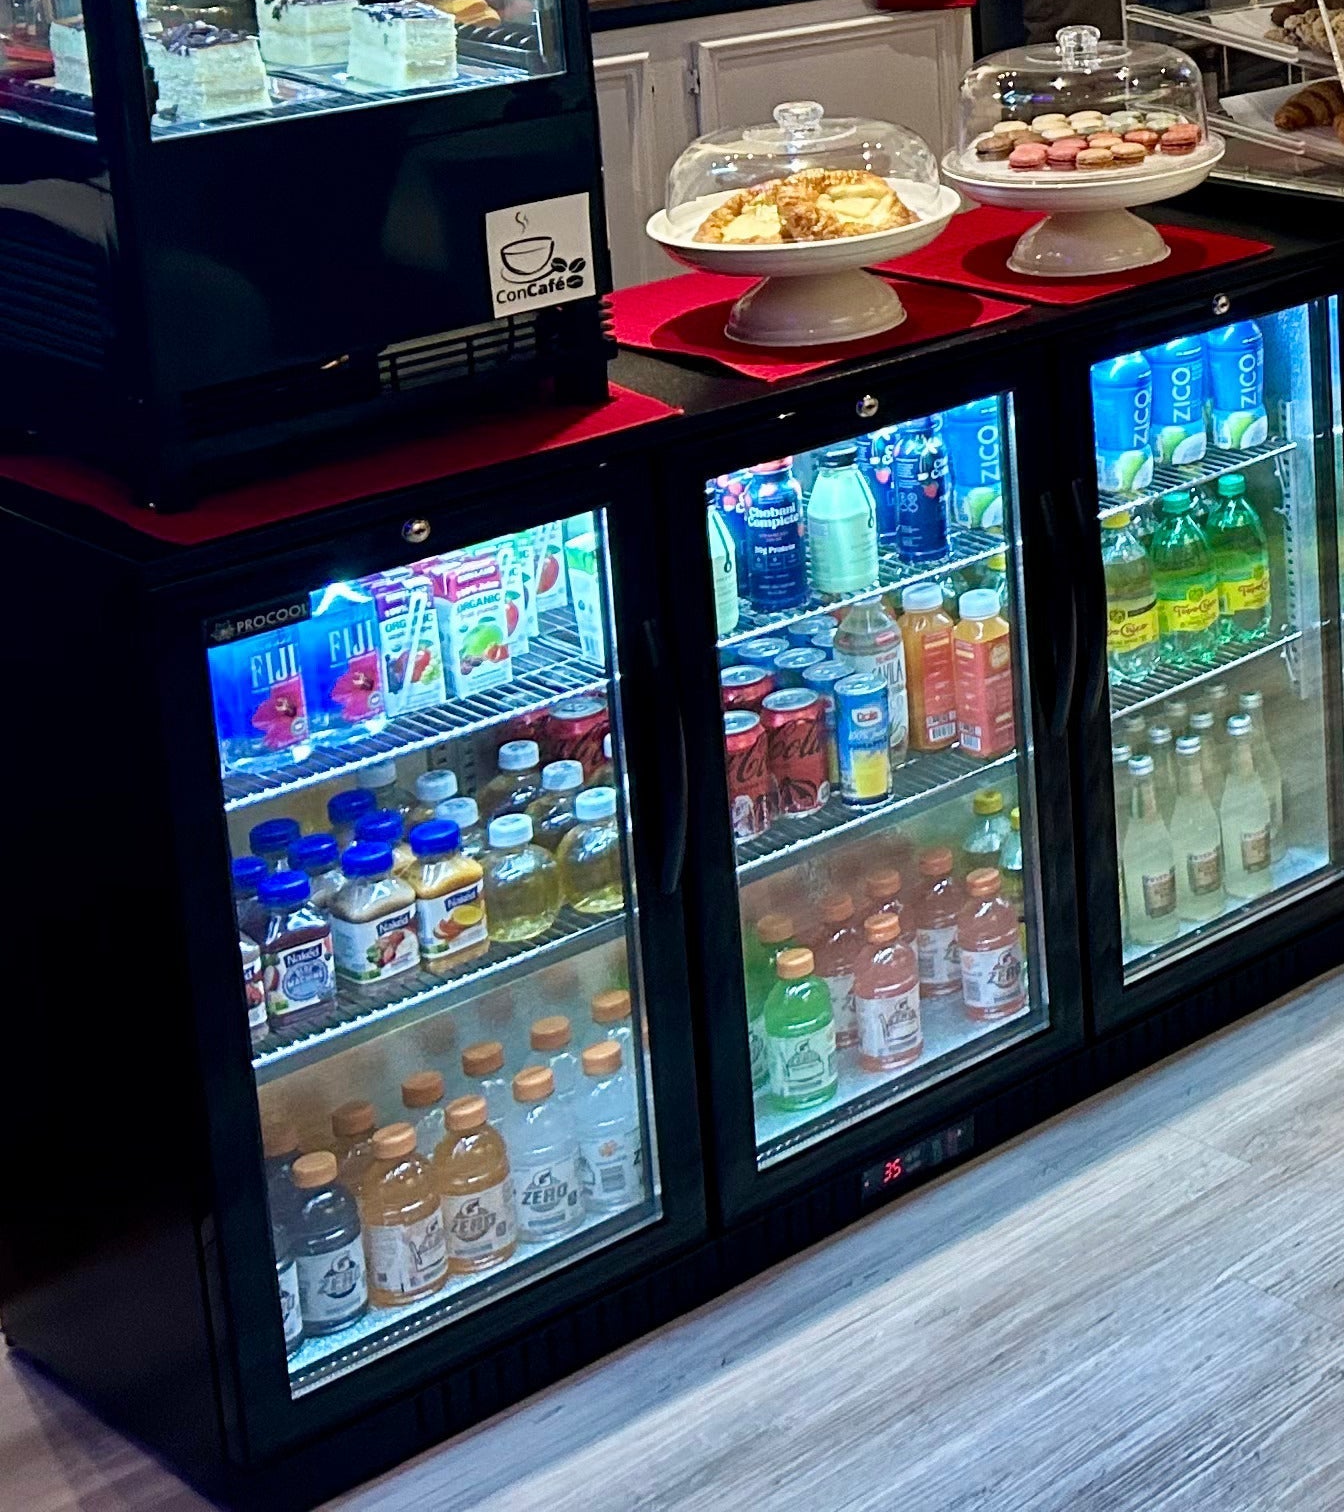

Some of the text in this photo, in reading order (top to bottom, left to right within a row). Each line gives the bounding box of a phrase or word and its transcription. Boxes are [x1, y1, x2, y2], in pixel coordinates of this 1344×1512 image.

[496, 276, 565, 304] ConCafé
[1239, 353, 1257, 409] ZICO
[1171, 367, 1191, 424] ZICO
[1134, 389, 1150, 448] ZICO
[977, 425, 1000, 484] ZICO
[748, 513, 799, 530] Complete
[749, 502, 796, 518] Chobani
[457, 593, 501, 613] ORGANIC
[329, 620, 375, 663] FIJI
[251, 644, 299, 688] FIJI
[857, 711, 878, 722] Dole
[448, 890, 477, 908] Naked
[377, 914, 410, 934] Naked
[286, 945, 321, 965] Naked
[883, 1158, 901, 1183] 35
[521, 1182, 568, 1205] ZERO
[452, 1212, 496, 1233] ZERO
